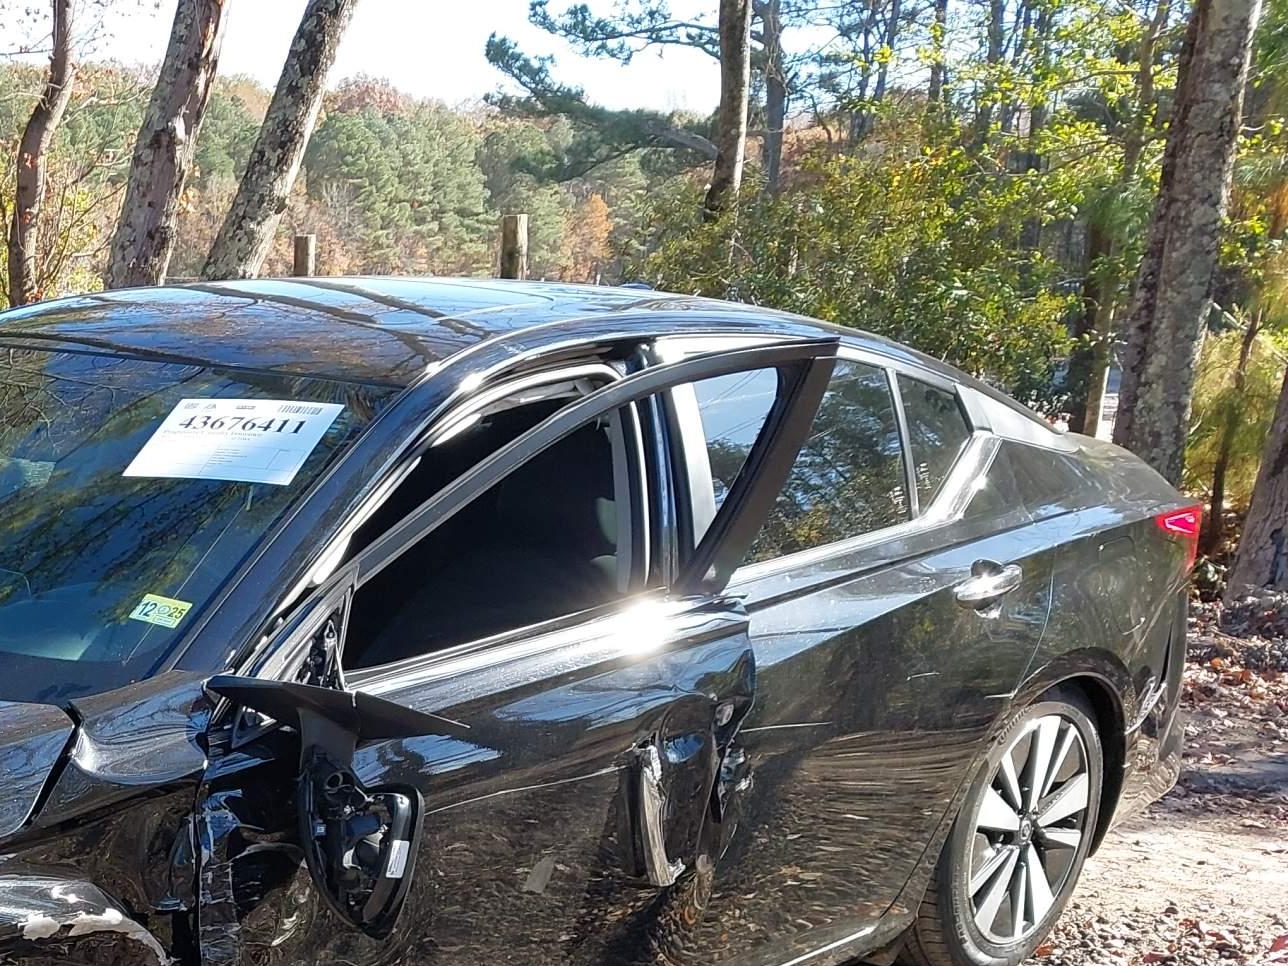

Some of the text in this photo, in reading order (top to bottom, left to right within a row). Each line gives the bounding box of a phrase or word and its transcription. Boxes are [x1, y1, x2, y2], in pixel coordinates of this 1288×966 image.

[178, 415, 307, 435] 43676411
[138, 601, 186, 619] 12 25
